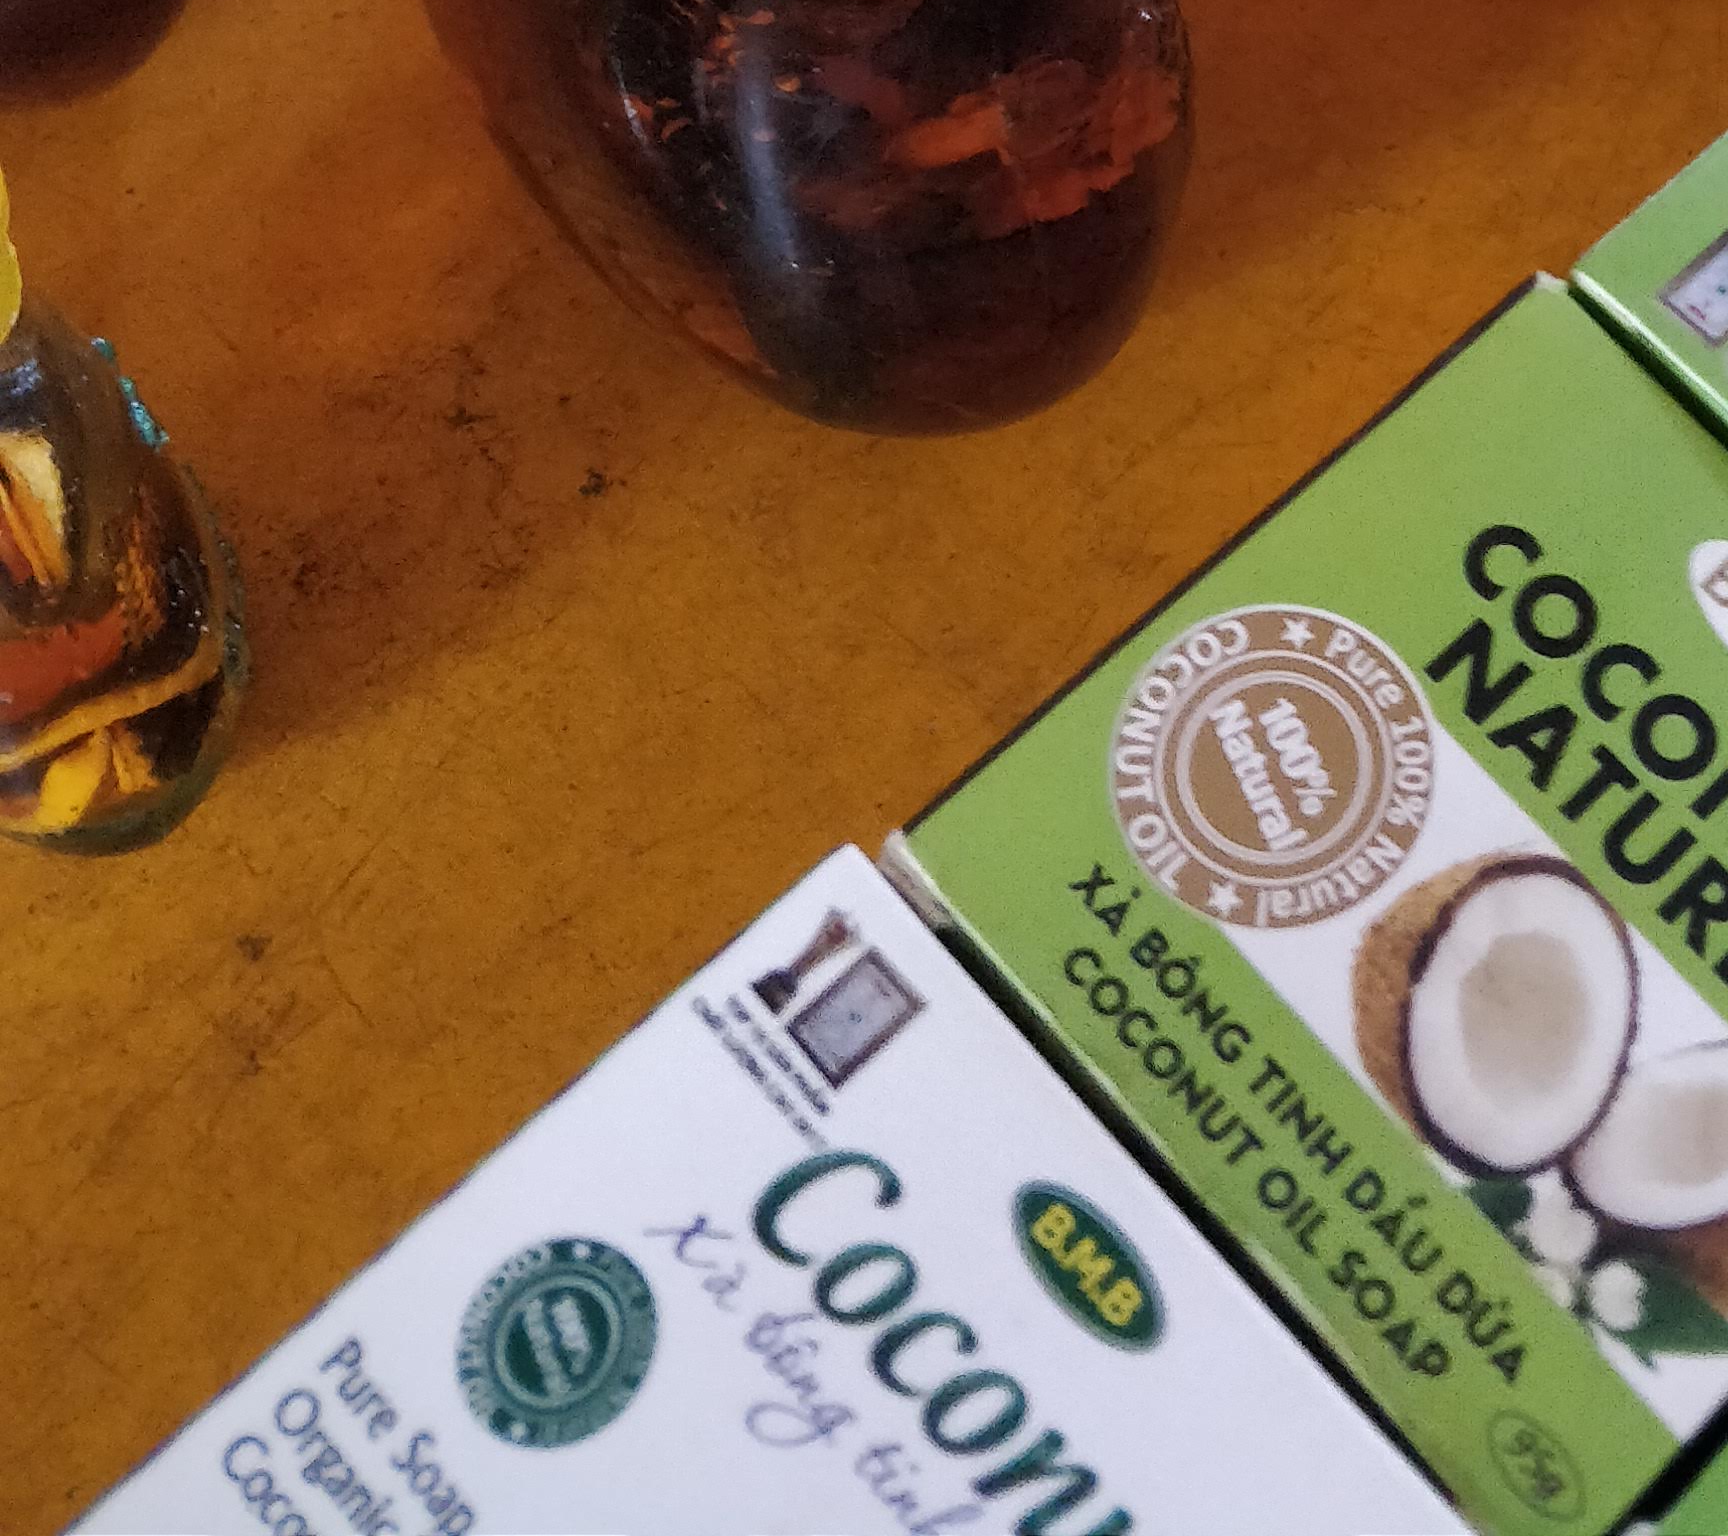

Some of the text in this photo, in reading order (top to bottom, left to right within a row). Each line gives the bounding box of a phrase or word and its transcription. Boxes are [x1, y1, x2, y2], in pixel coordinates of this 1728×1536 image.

[1114, 619, 1250, 892] COCONUT OIL
[1207, 699, 1308, 852] Natural
[1254, 627, 1431, 927] Pure 100% Natural
[1258, 697, 1338, 818] 100%
[1062, 946, 1455, 1378] COCONUT OIL SOAP
[1248, 1054, 1355, 1177] TINH
[319, 1334, 397, 1440] Pure
